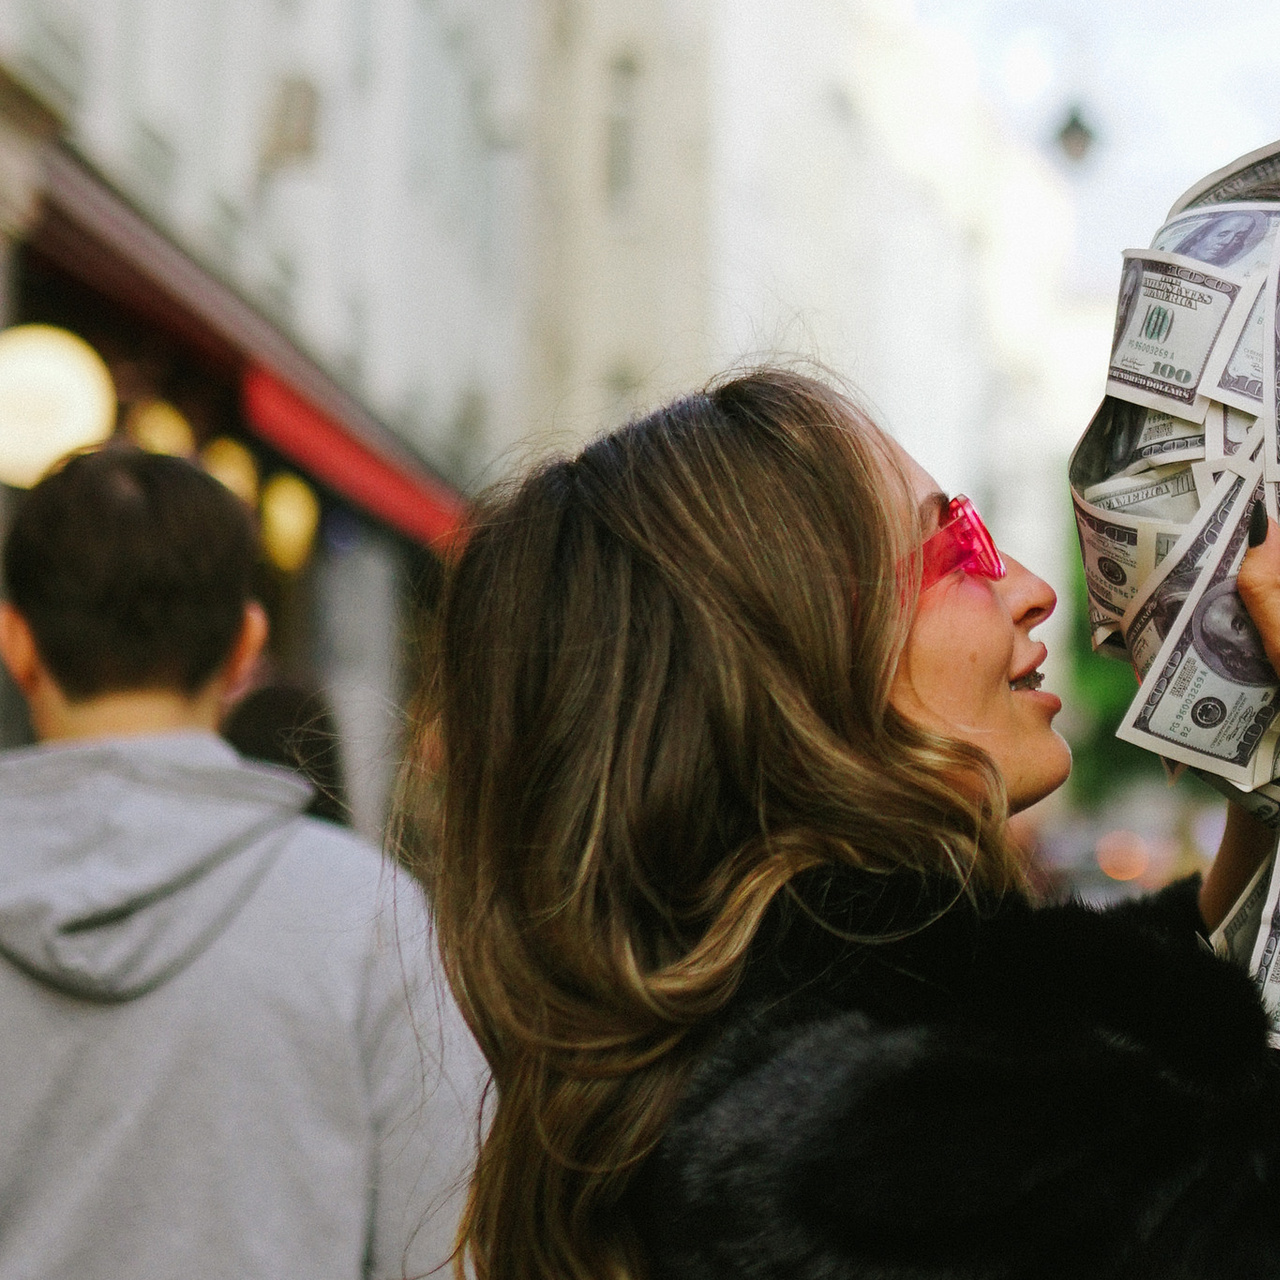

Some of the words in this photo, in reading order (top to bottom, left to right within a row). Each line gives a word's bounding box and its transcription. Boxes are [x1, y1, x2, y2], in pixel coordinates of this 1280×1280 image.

[1167, 264, 1233, 293] 100
[1139, 303, 1176, 345] 100
[1145, 380, 1189, 398] DOLLARS
[1150, 360, 1192, 384] 100
[1140, 649, 1184, 717] 100
[1168, 719, 1180, 733] FG
[1174, 676, 1205, 721] 96003269
[1179, 725, 1191, 738] B2
[1254, 935, 1278, 985] 00
